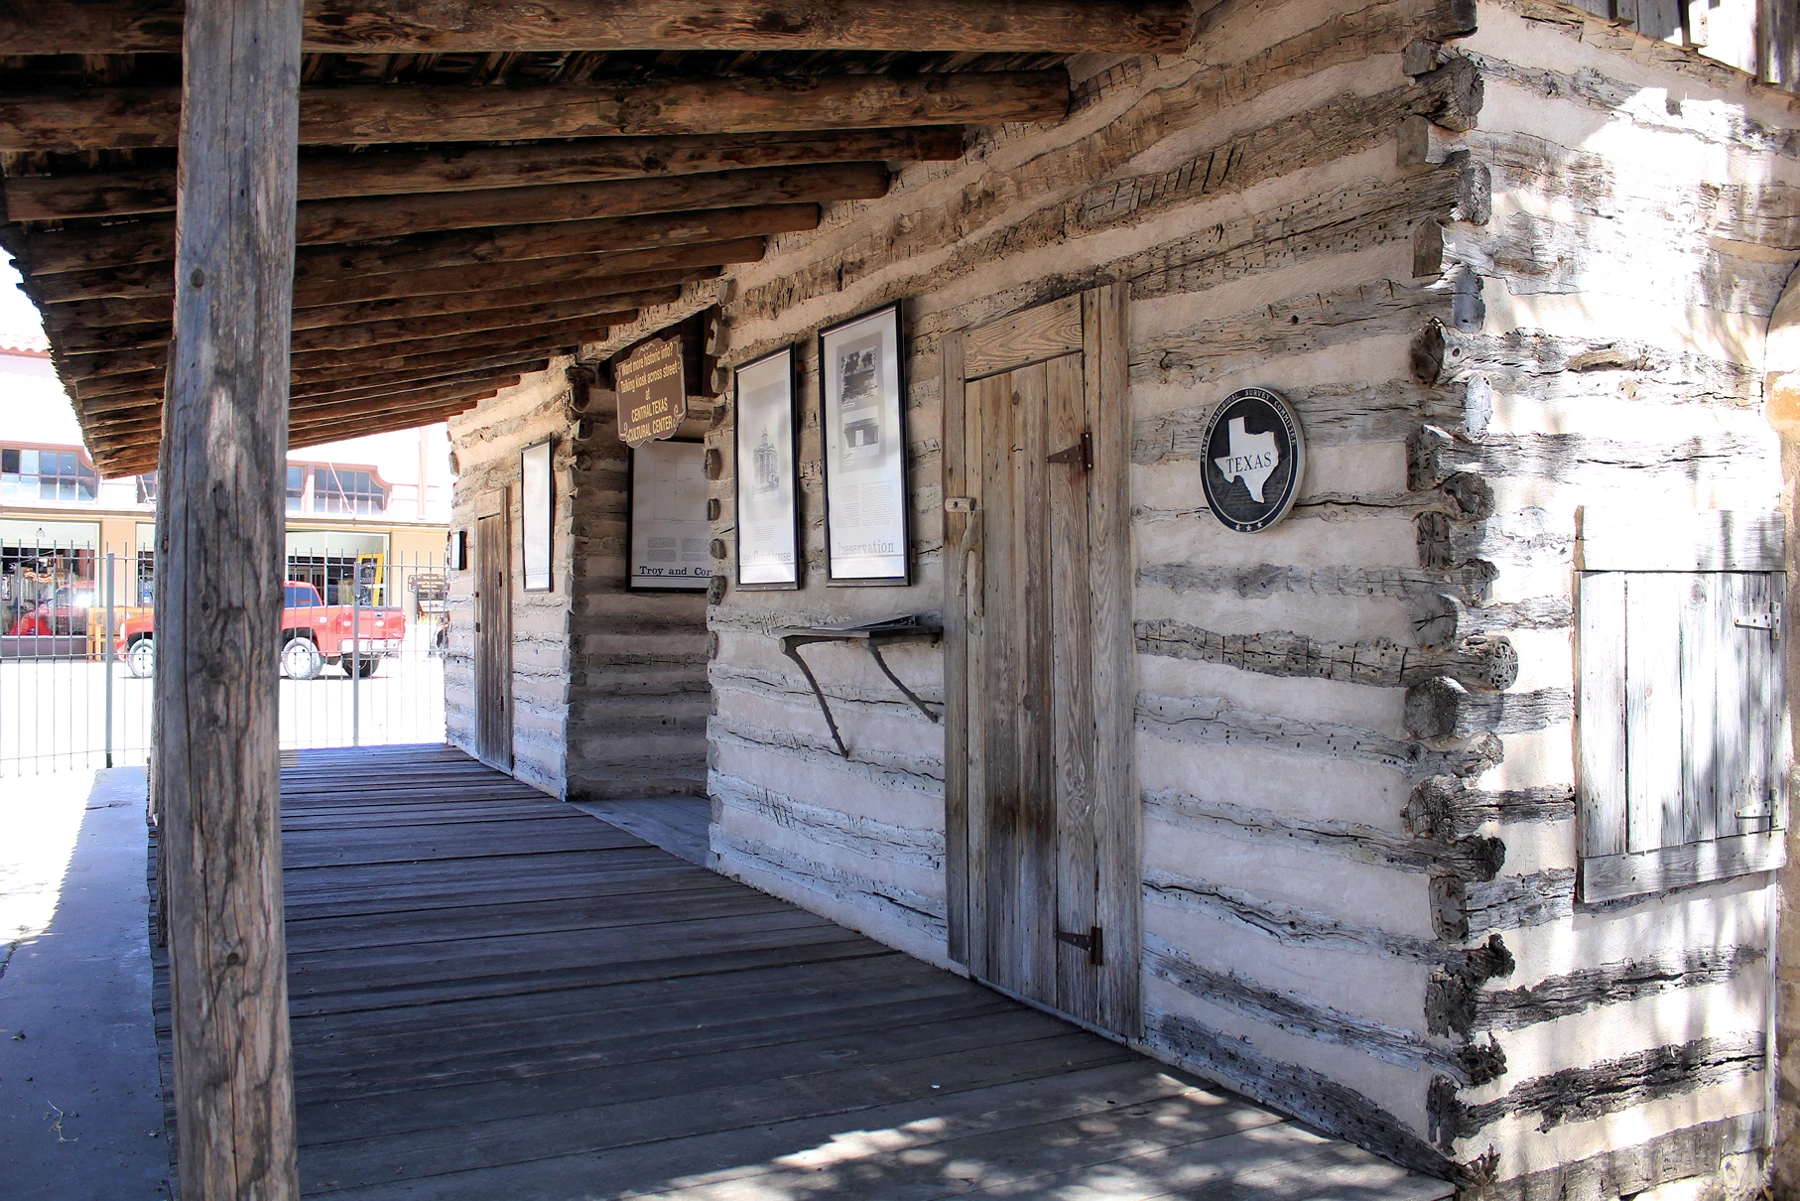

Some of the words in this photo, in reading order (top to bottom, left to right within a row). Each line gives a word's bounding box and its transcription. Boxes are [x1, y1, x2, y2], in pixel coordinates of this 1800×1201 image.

[621, 360, 632, 376] Want
[632, 356, 644, 371] more
[644, 348, 661, 366] historic
[661, 342, 673, 359] info?
[620, 376, 636, 393] Talking
[635, 371, 648, 388] kiosk
[647, 368, 663, 383] across
[662, 360, 677, 378] street
[645, 388, 650, 400] at
[631, 403, 652, 423] CENTRAL
[652, 397, 668, 415] TEXAS
[1244, 390, 1270, 400] SURVEY
[1273, 400, 1298, 446] COMMITTEE
[628, 422, 652, 442] CULTURAL
[652, 414, 673, 435] CENTER
[1226, 451, 1272, 474] TEXAS
[836, 539, 895, 555] Preservation
[639, 566, 664, 577] Troy
[668, 566, 687, 576] and
